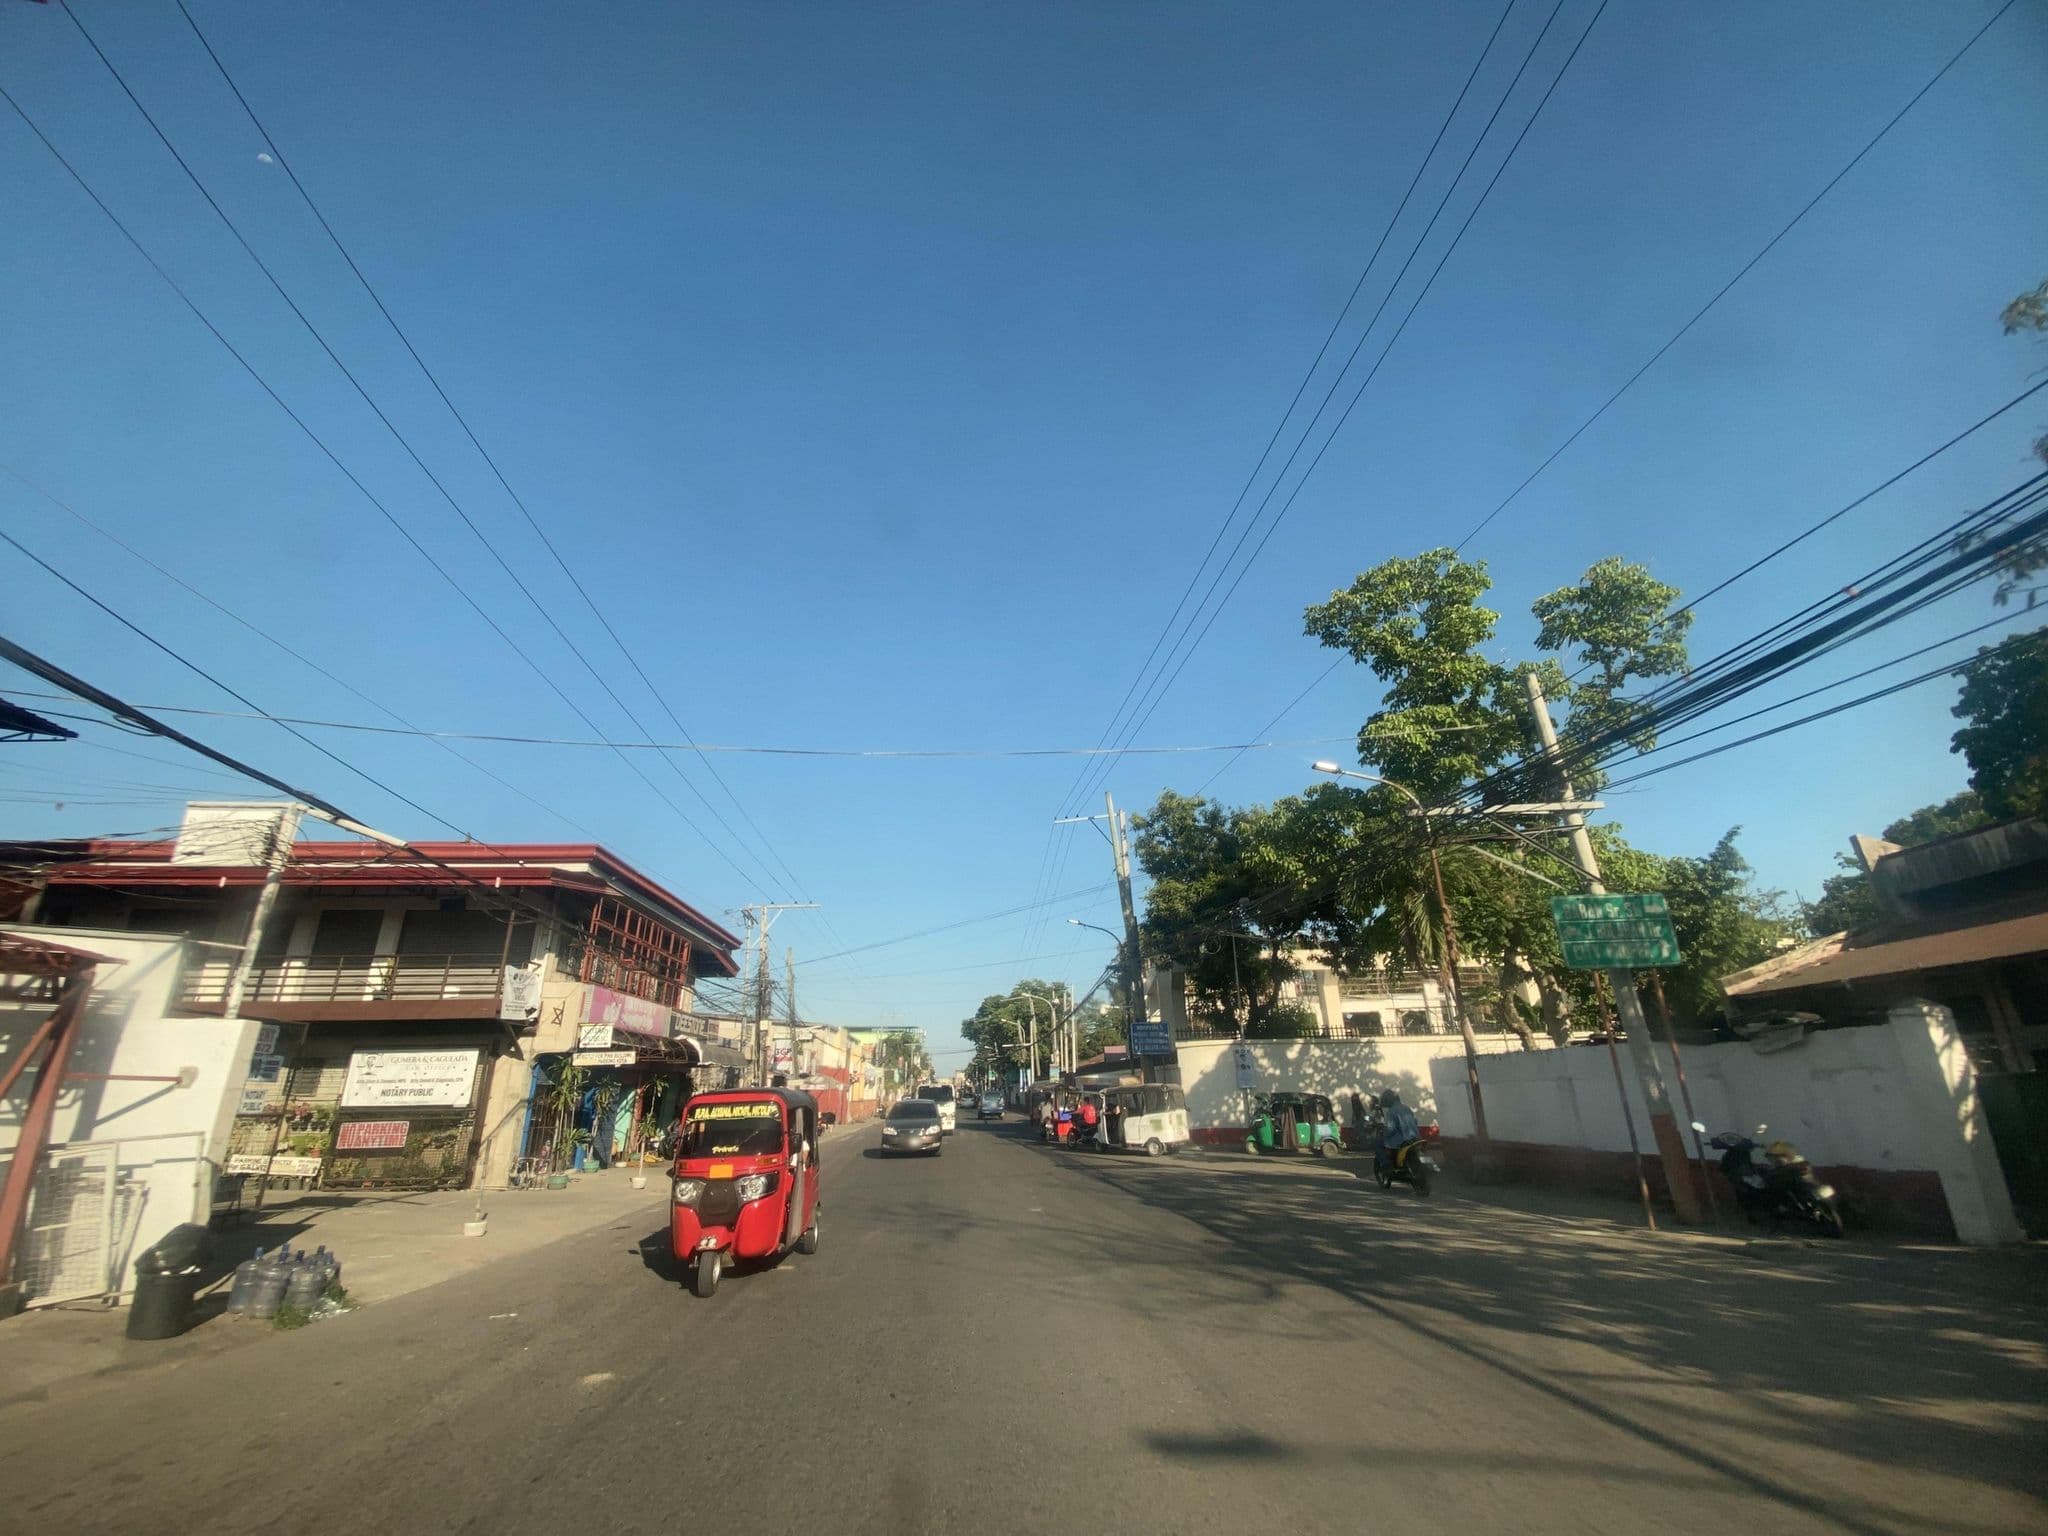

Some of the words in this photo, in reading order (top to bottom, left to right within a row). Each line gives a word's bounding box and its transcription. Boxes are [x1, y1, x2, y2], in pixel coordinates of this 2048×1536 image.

[380, 1089, 408, 1097] NOTARY
[409, 1088, 434, 1097] PUBLIC
[357, 1122, 408, 1136] PARKING
